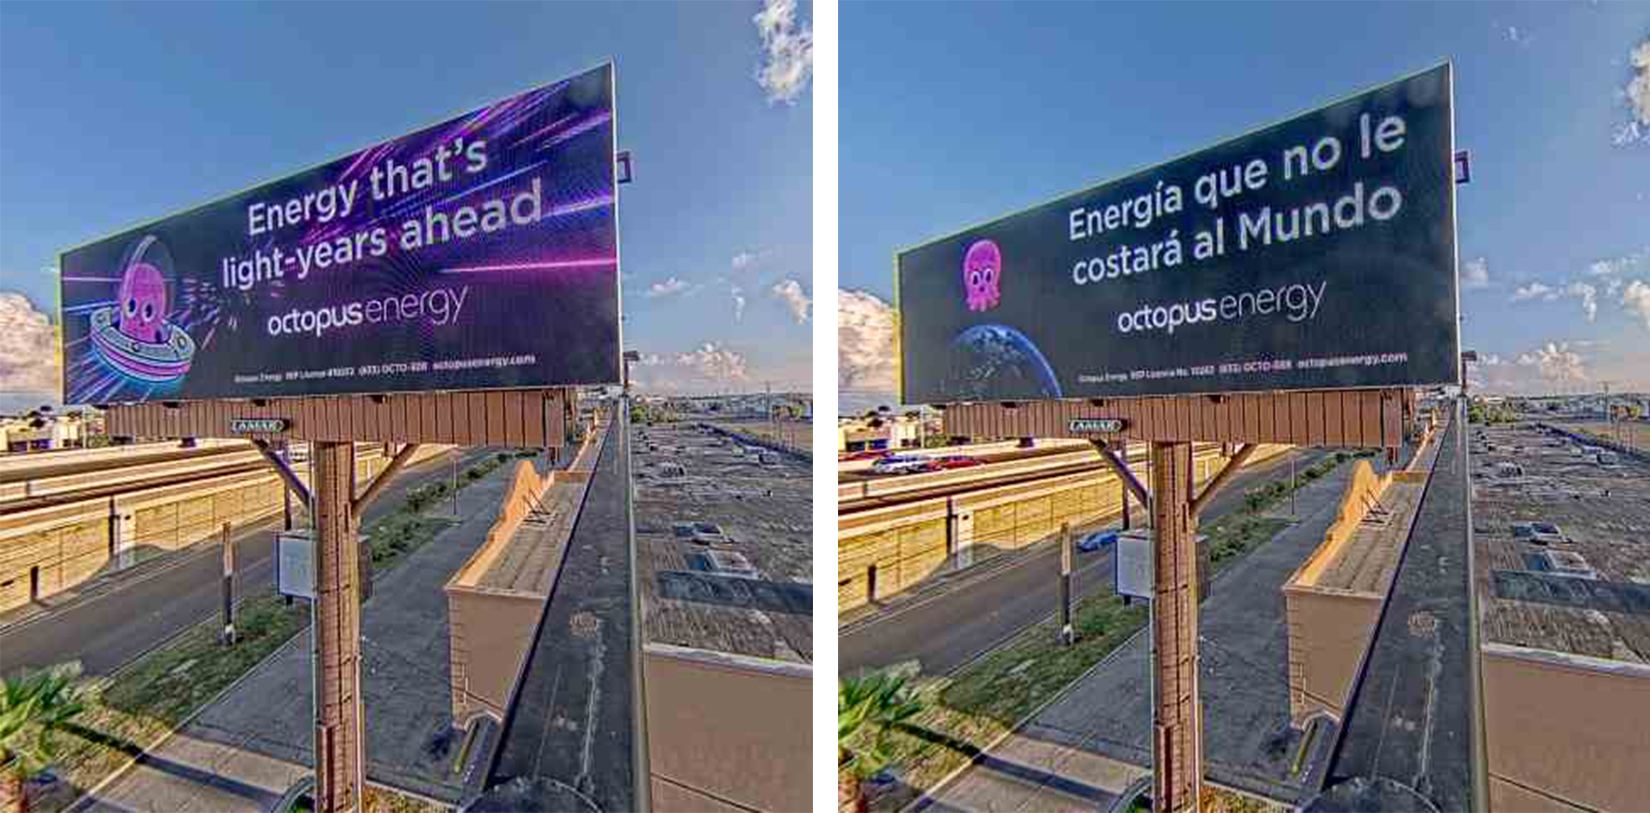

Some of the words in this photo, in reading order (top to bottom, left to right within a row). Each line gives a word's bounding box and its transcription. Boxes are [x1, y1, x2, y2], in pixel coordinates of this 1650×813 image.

[249, 179, 359, 236] Energy
[1068, 180, 1183, 241] Energía
[1194, 158, 1269, 208] que
[1284, 136, 1341, 181] no
[1359, 112, 1407, 159] le
[223, 224, 387, 291] light-years
[400, 177, 543, 250] ahead
[1072, 229, 1183, 286] costará
[1193, 217, 1224, 261] al
[1238, 181, 1402, 250] Mundo
[432, 353, 536, 371] octopusenergy.com
[1297, 352, 1408, 369] octopusenergy.com
